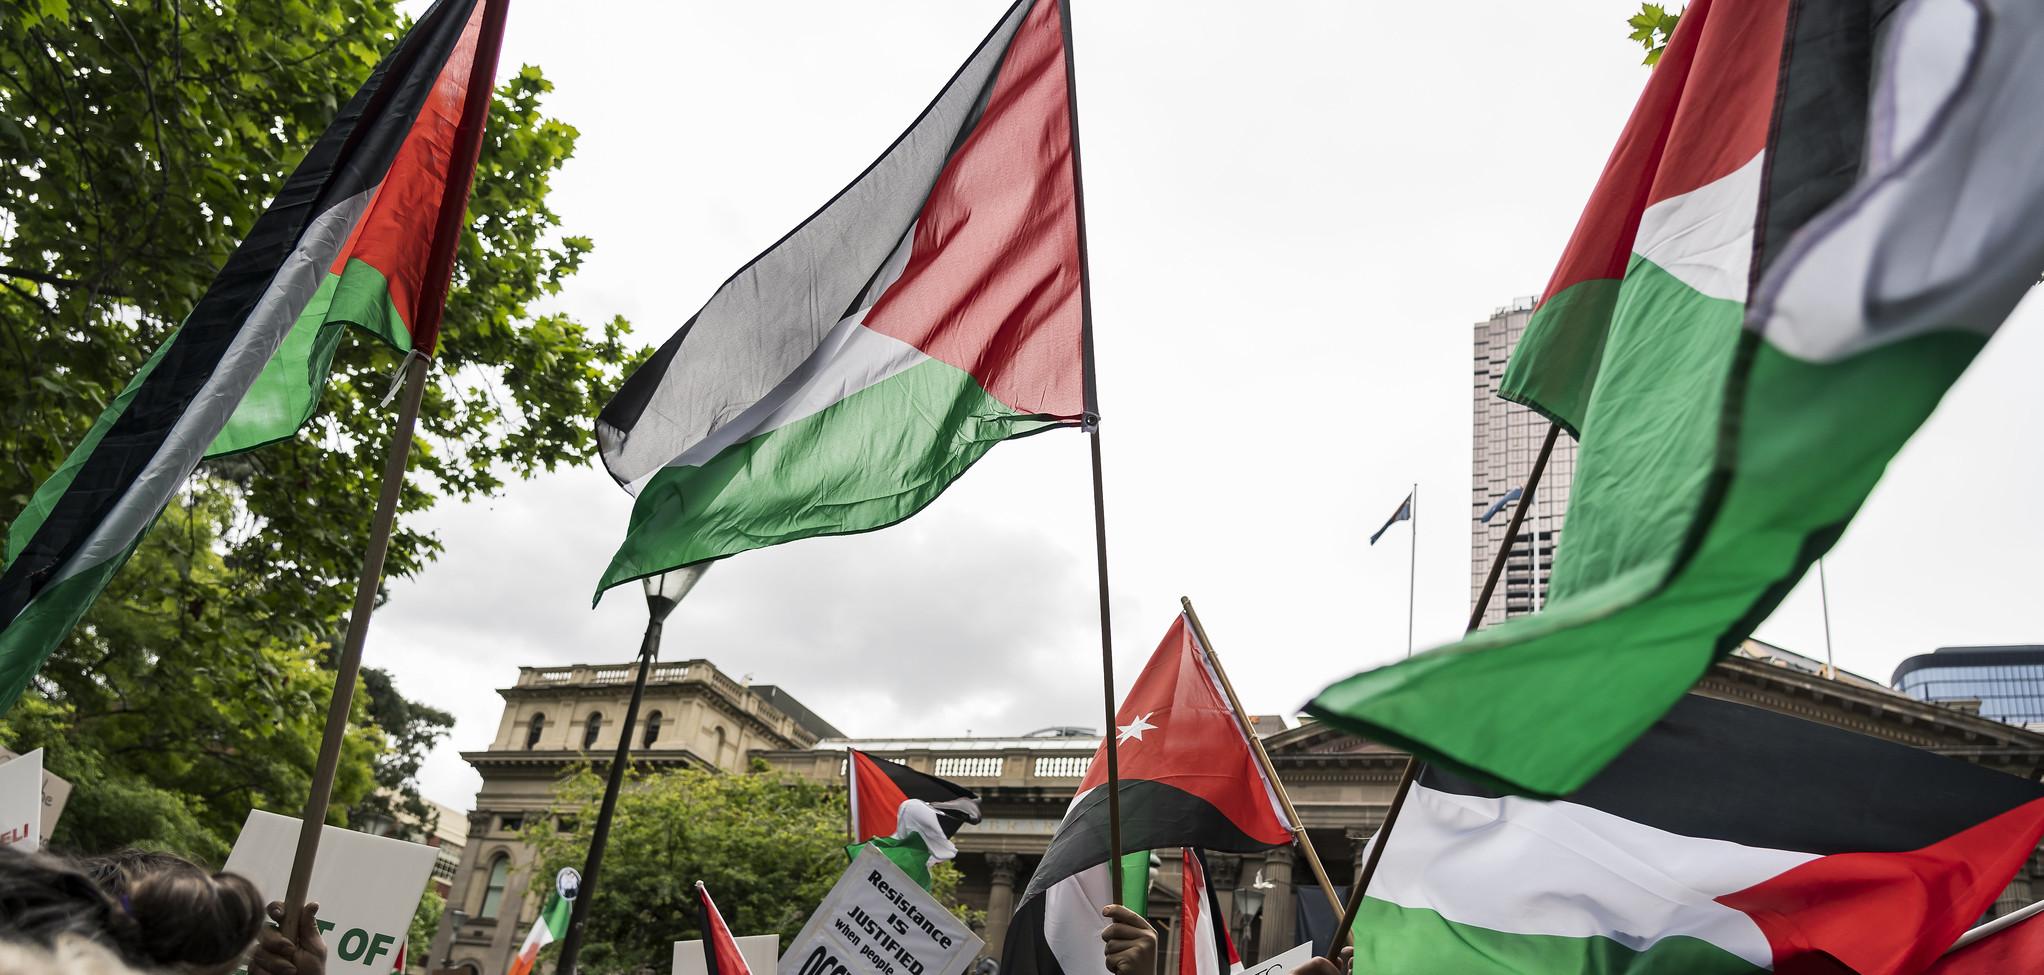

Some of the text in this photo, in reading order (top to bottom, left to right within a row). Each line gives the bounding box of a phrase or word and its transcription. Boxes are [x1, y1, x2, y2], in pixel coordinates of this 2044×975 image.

[867, 869, 952, 950] Resistance
[887, 912, 910, 936] IS
[337, 928, 396, 967] OF
[834, 918, 861, 946] when
[859, 944, 894, 975] people
[847, 905, 924, 975] JUSTIFIED
